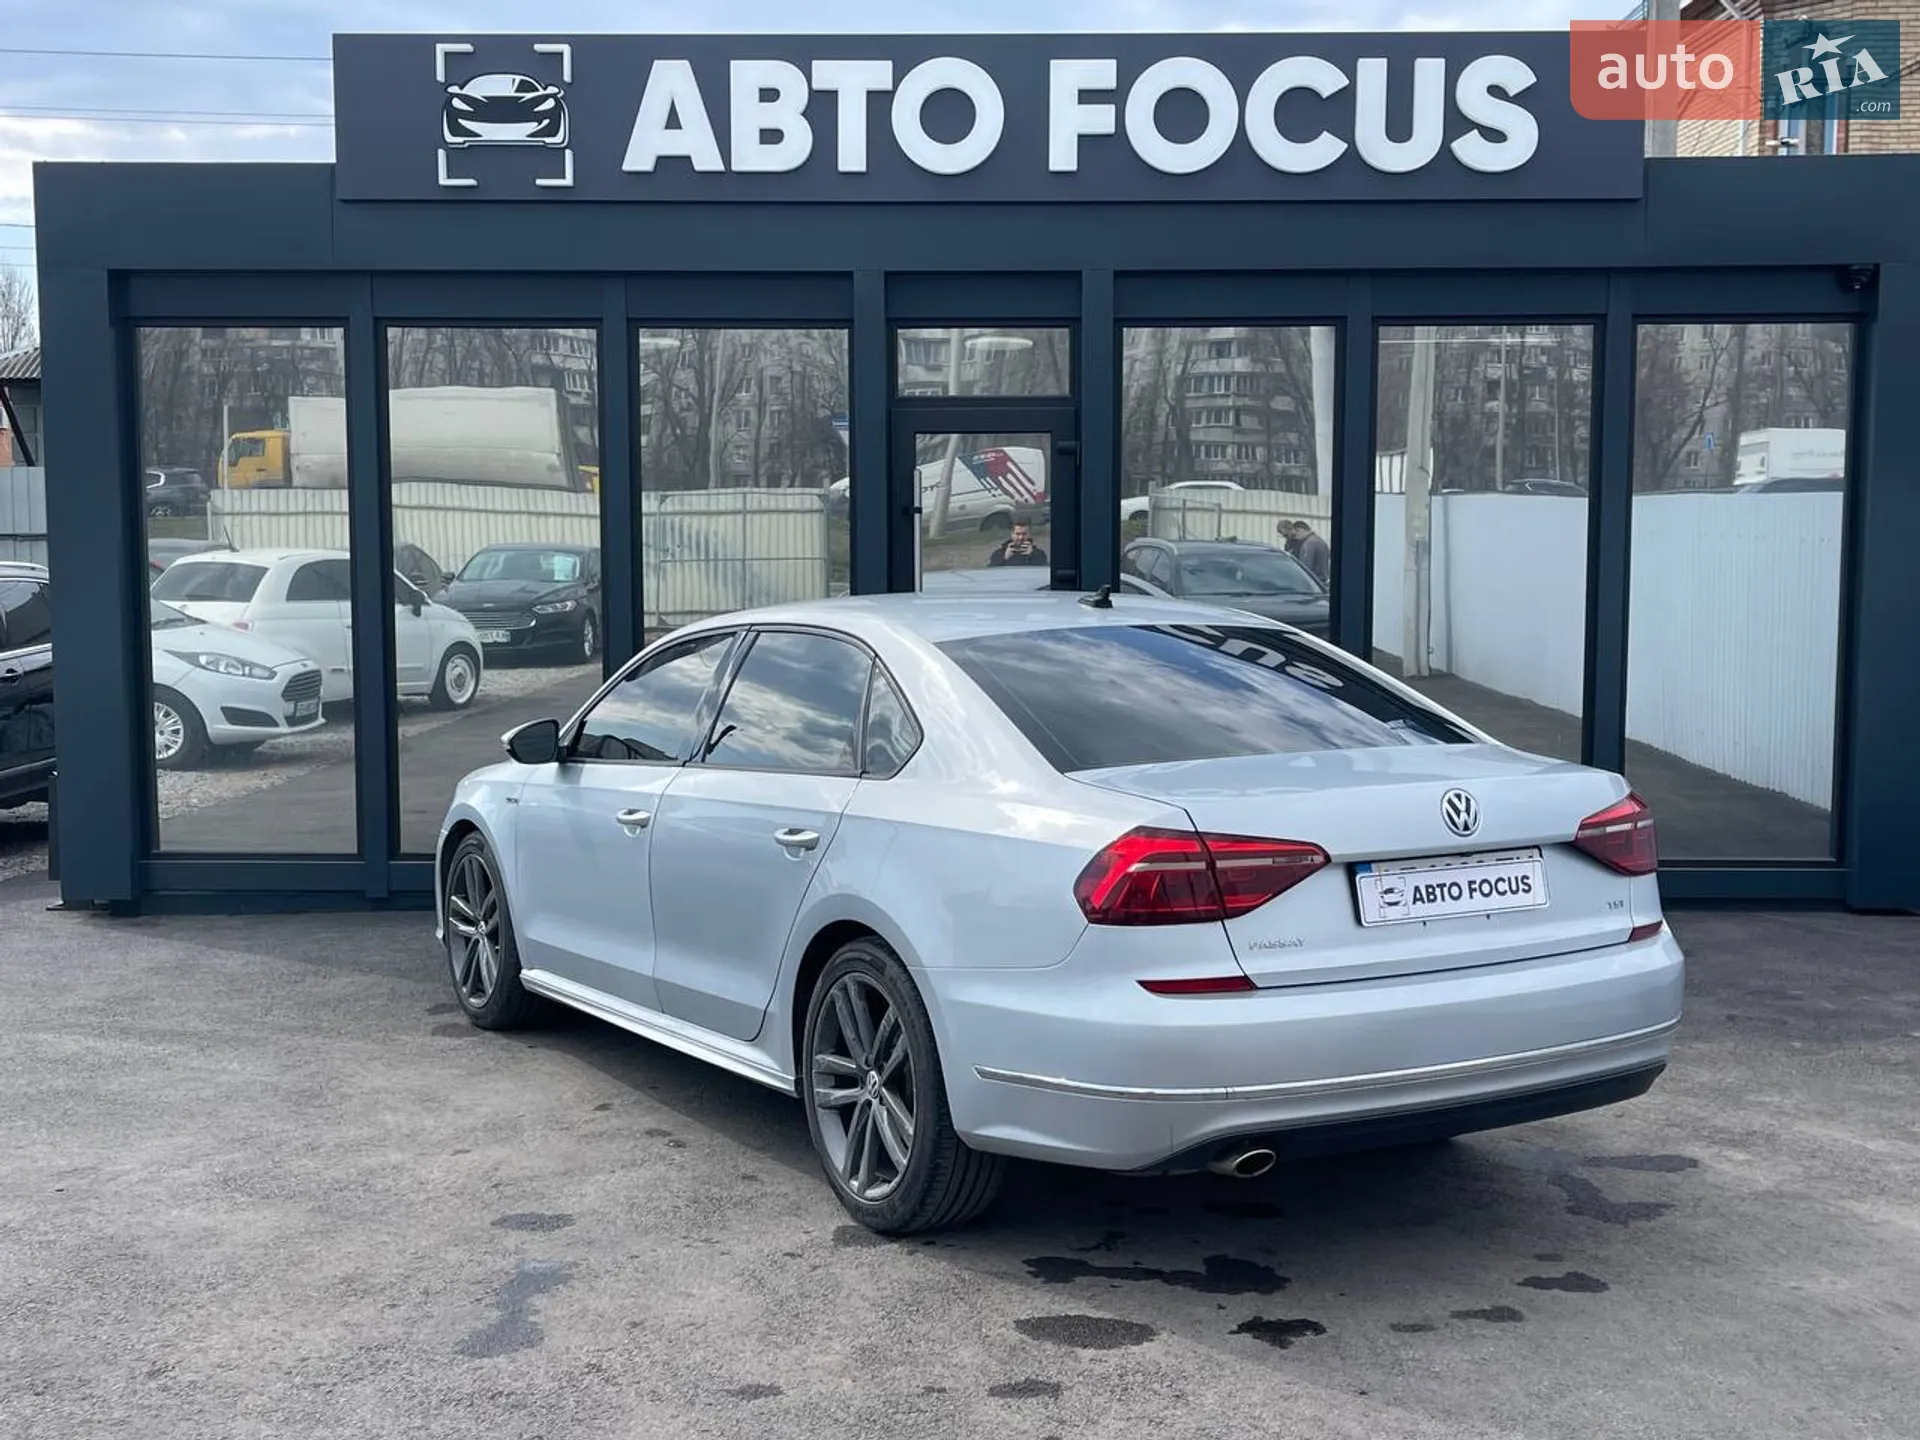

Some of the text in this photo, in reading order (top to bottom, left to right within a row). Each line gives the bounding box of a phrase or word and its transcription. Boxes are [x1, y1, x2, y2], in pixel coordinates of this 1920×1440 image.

[621, 55, 1540, 175] АВТО FOCUS
[1412, 874, 1532, 905] АВТО FOCUS
